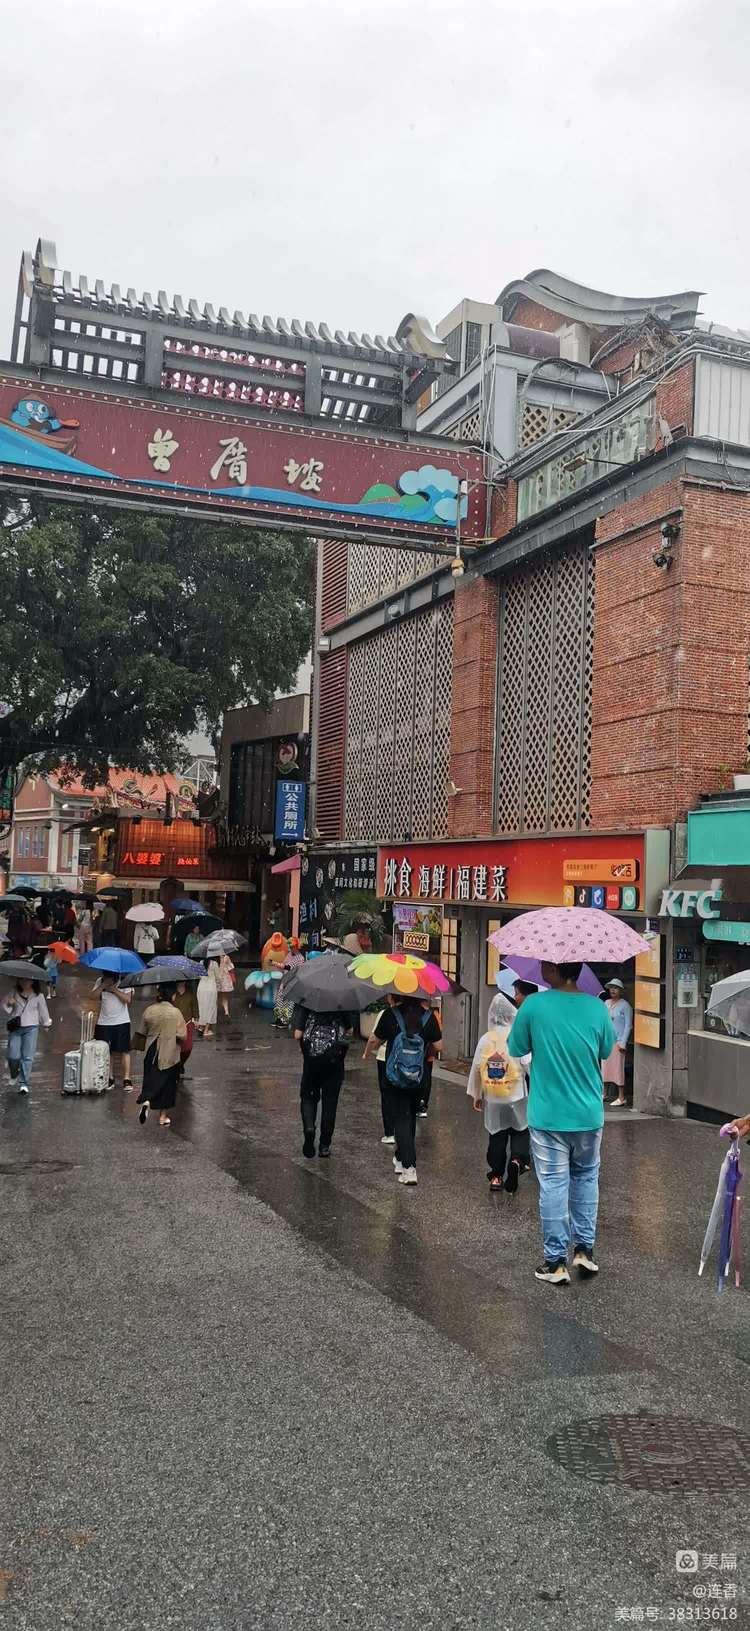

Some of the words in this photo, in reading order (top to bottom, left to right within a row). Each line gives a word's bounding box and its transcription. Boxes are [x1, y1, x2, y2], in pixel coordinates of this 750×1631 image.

[283, 792, 299, 830] 公共厕所
[384, 857, 411, 896] 挑食
[418, 864, 445, 898] 海鲜
[457, 864, 506, 901] 福建菜
[658, 890, 722, 919] KFC
